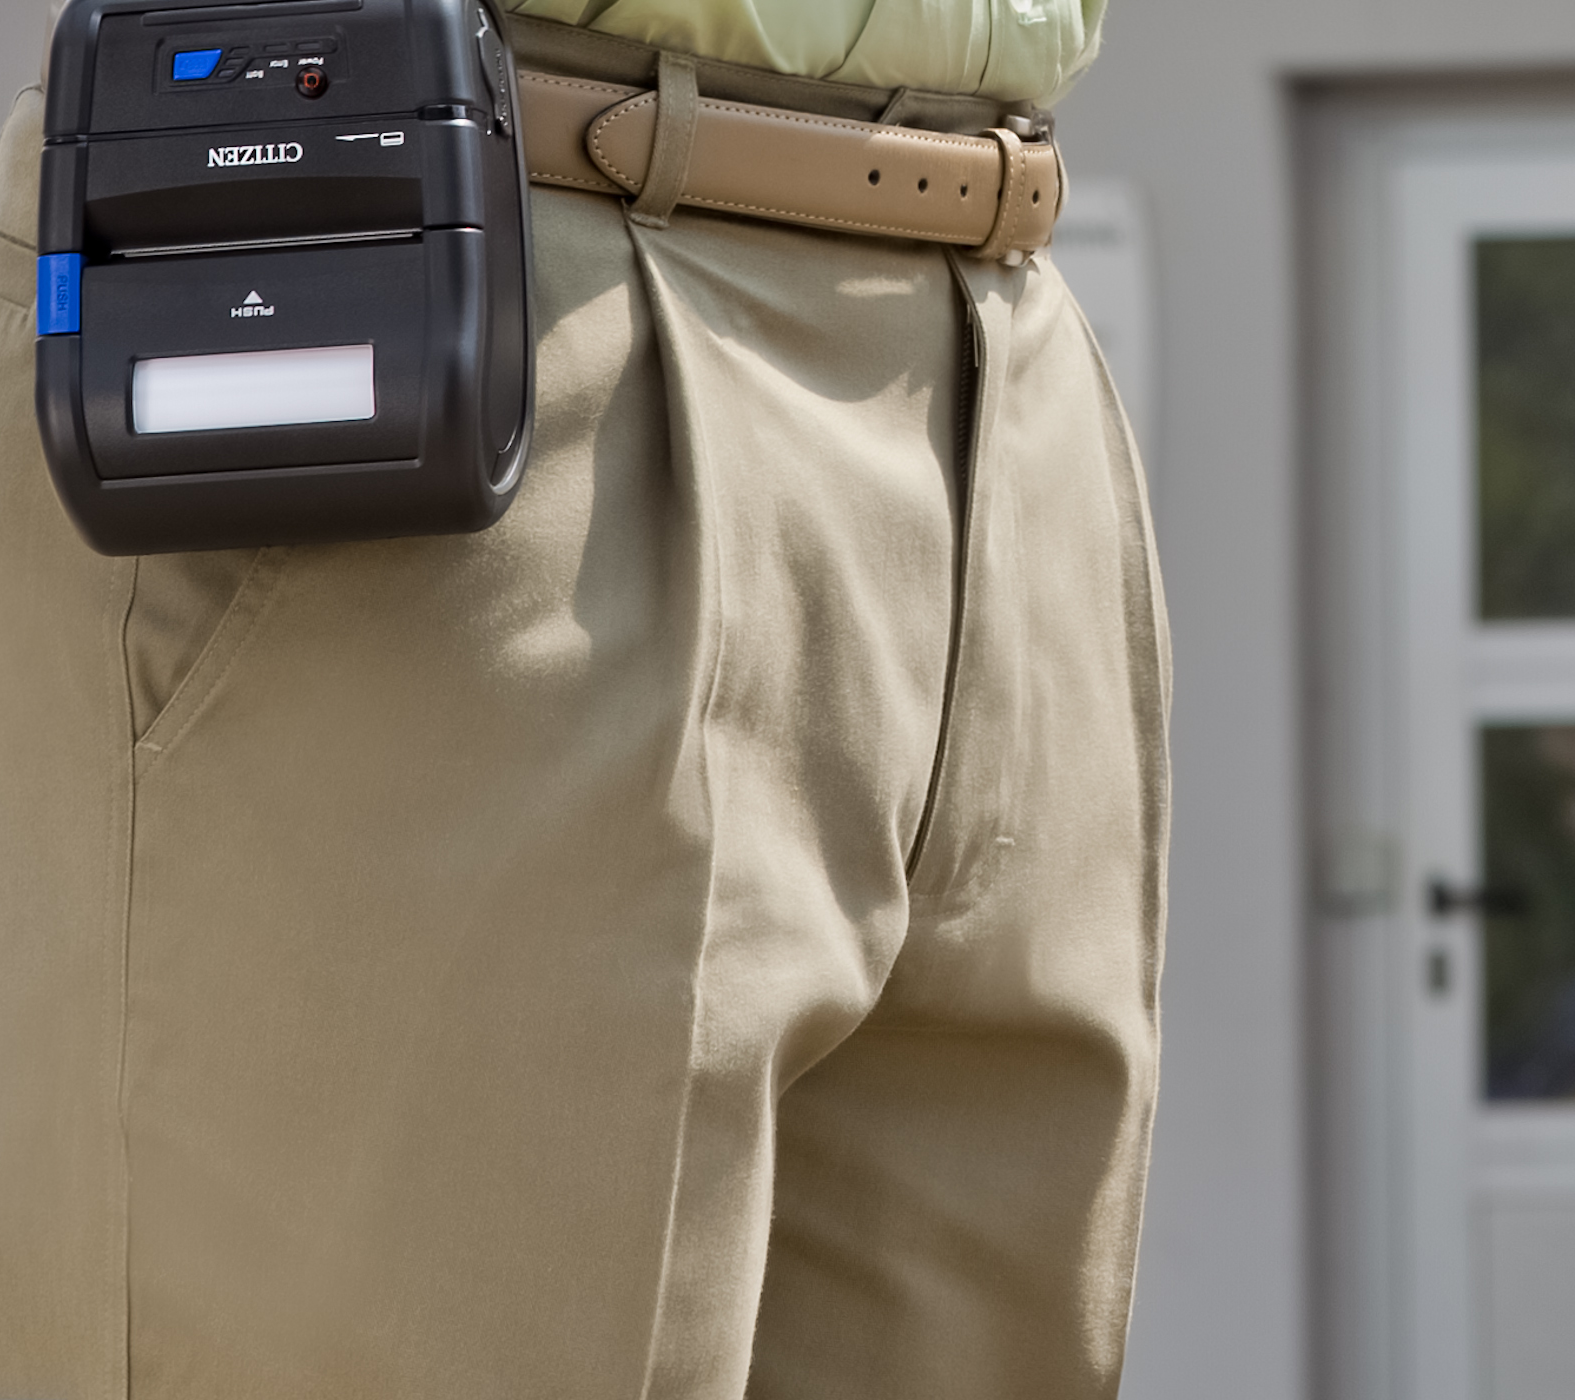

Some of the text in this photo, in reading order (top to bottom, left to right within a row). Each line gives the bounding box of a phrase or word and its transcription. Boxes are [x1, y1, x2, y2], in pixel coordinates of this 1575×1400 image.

[207, 142, 304, 167] CITIZEN
[56, 274, 69, 312] PUSH
[230, 305, 275, 318] PUSH
